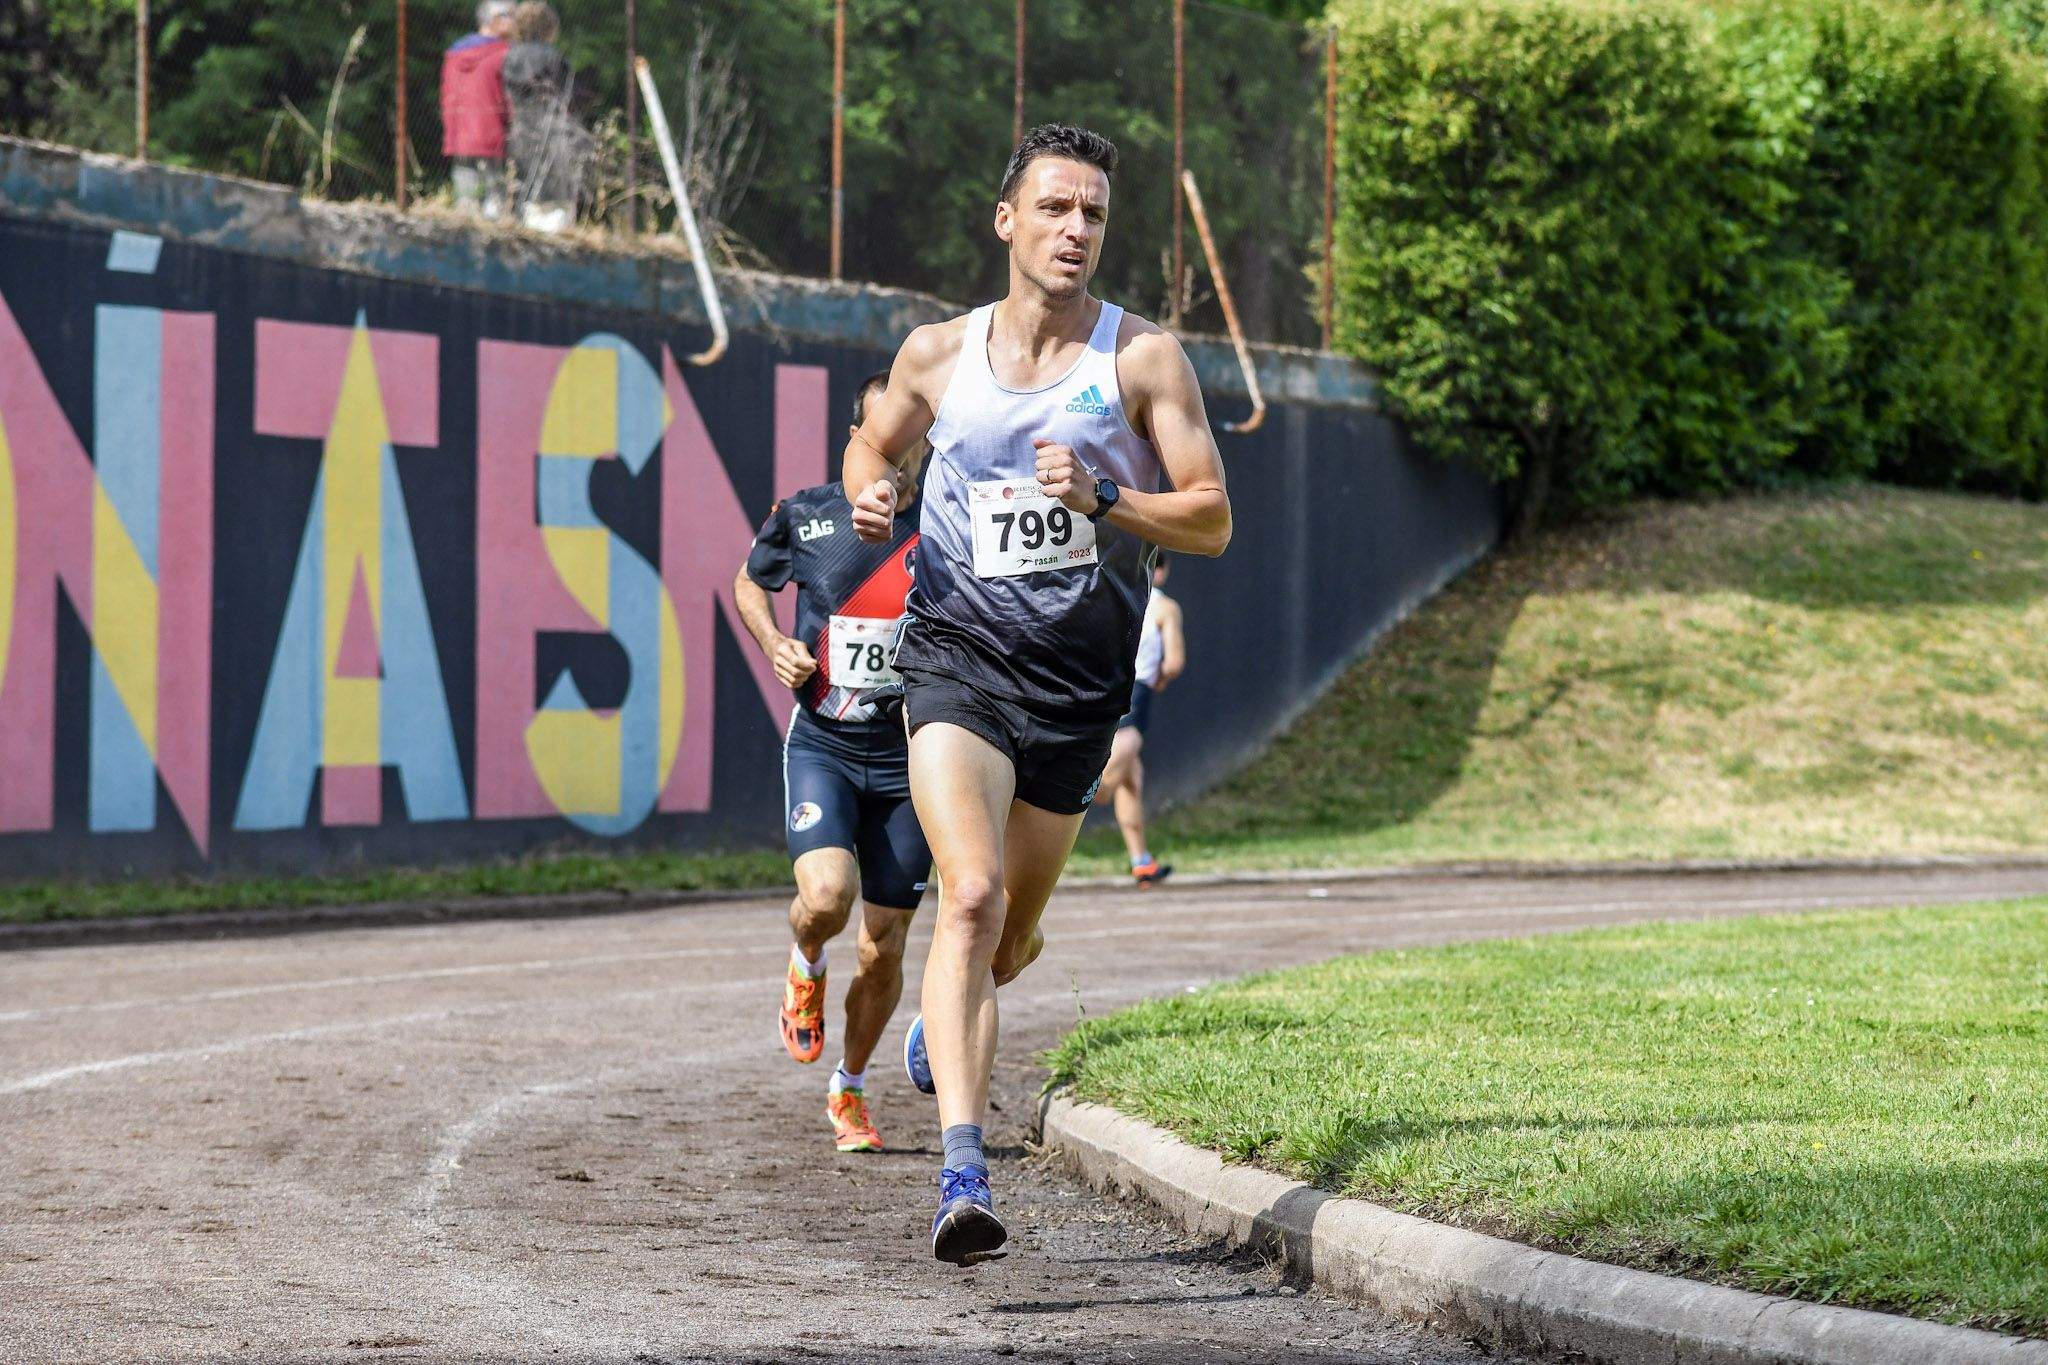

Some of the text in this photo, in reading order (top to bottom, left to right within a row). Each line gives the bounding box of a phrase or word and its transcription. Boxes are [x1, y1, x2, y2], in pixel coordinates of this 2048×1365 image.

[1065, 402, 1112, 416] adidas
[797, 518, 836, 543] CAG
[991, 506, 1072, 552] 799
[1067, 548, 1091, 560] 2023
[846, 642, 896, 672] 78
